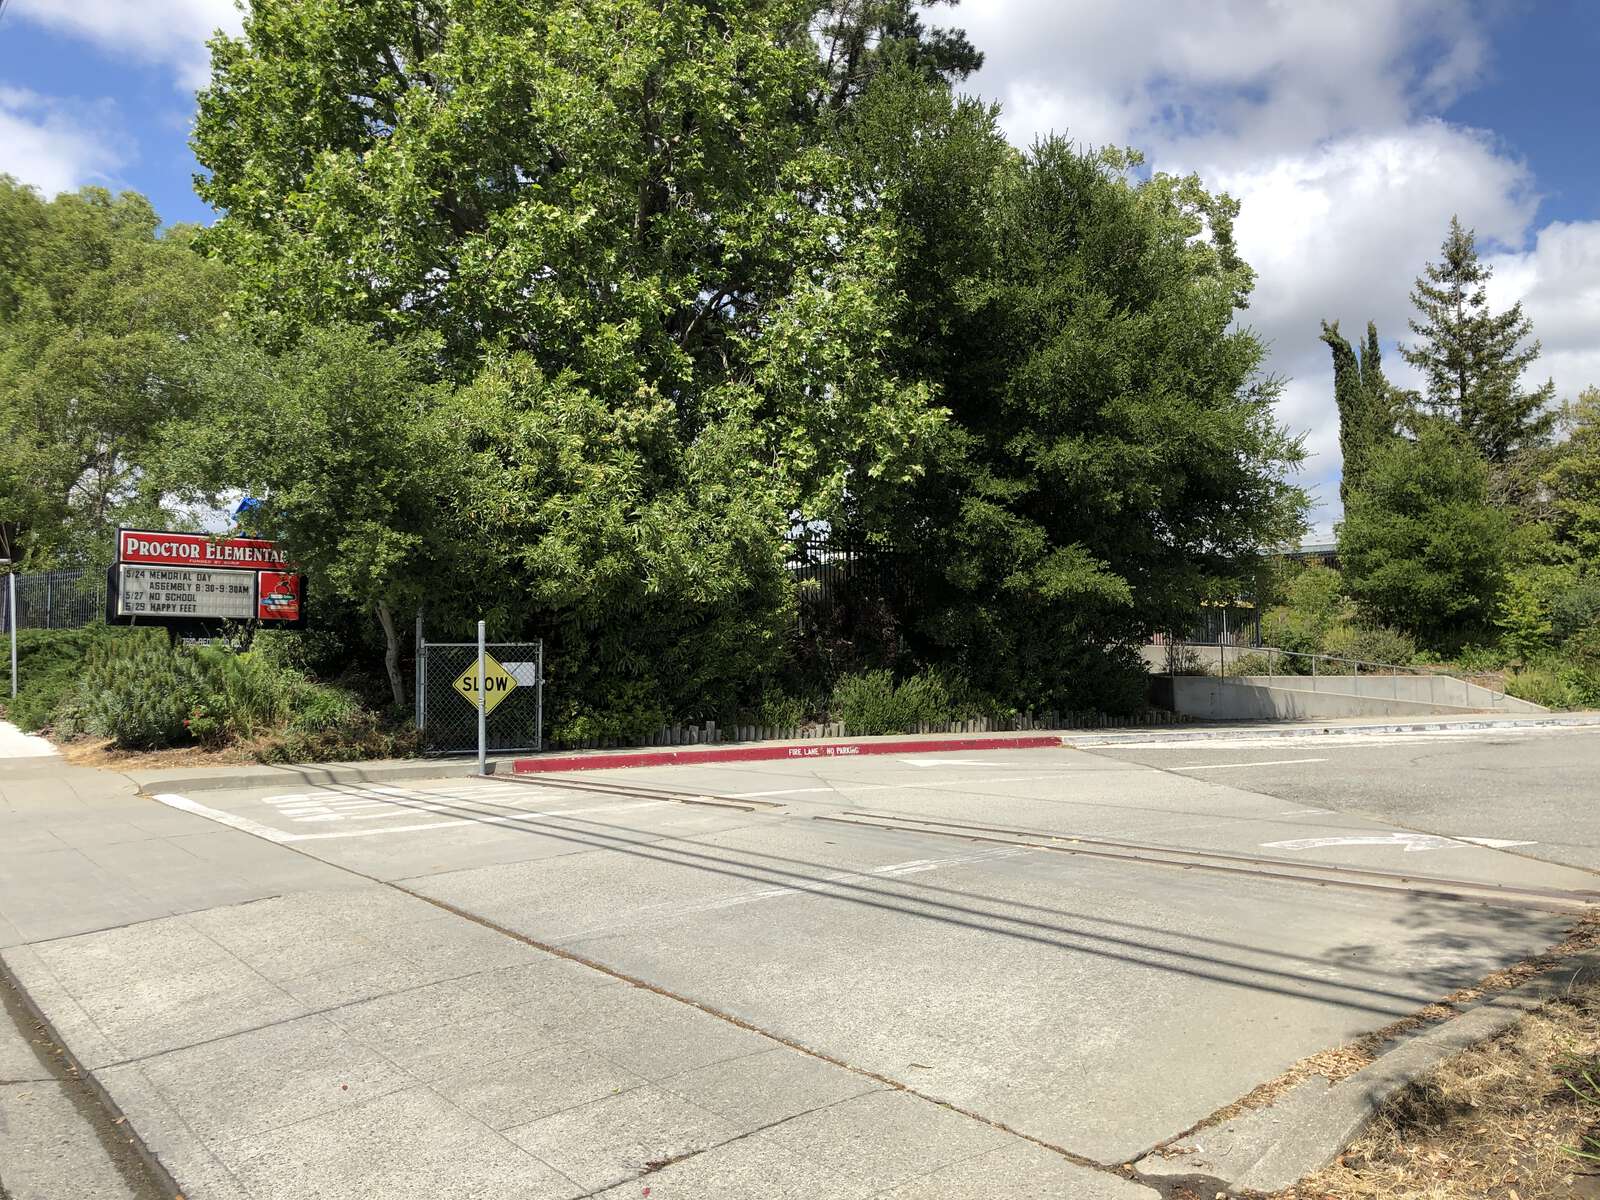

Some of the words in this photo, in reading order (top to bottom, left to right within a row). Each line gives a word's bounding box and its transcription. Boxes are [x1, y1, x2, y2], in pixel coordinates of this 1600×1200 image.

[127, 537, 200, 558] PROCTOR
[206, 543, 288, 564] ELEMENTAR
[126, 570, 145, 579] 5/24
[149, 571, 192, 581] MEMORIAL
[197, 573, 212, 582] DAY
[149, 582, 192, 591] ASSEMBLY
[125, 592, 143, 600] 5/27
[149, 593, 161, 601] NO
[165, 593, 197, 602] SCHOOL
[150, 603, 177, 612] HAPPY
[179, 604, 197, 613] FEET
[462, 676, 508, 692] SLOW
[836, 746, 860, 754] PARKING
